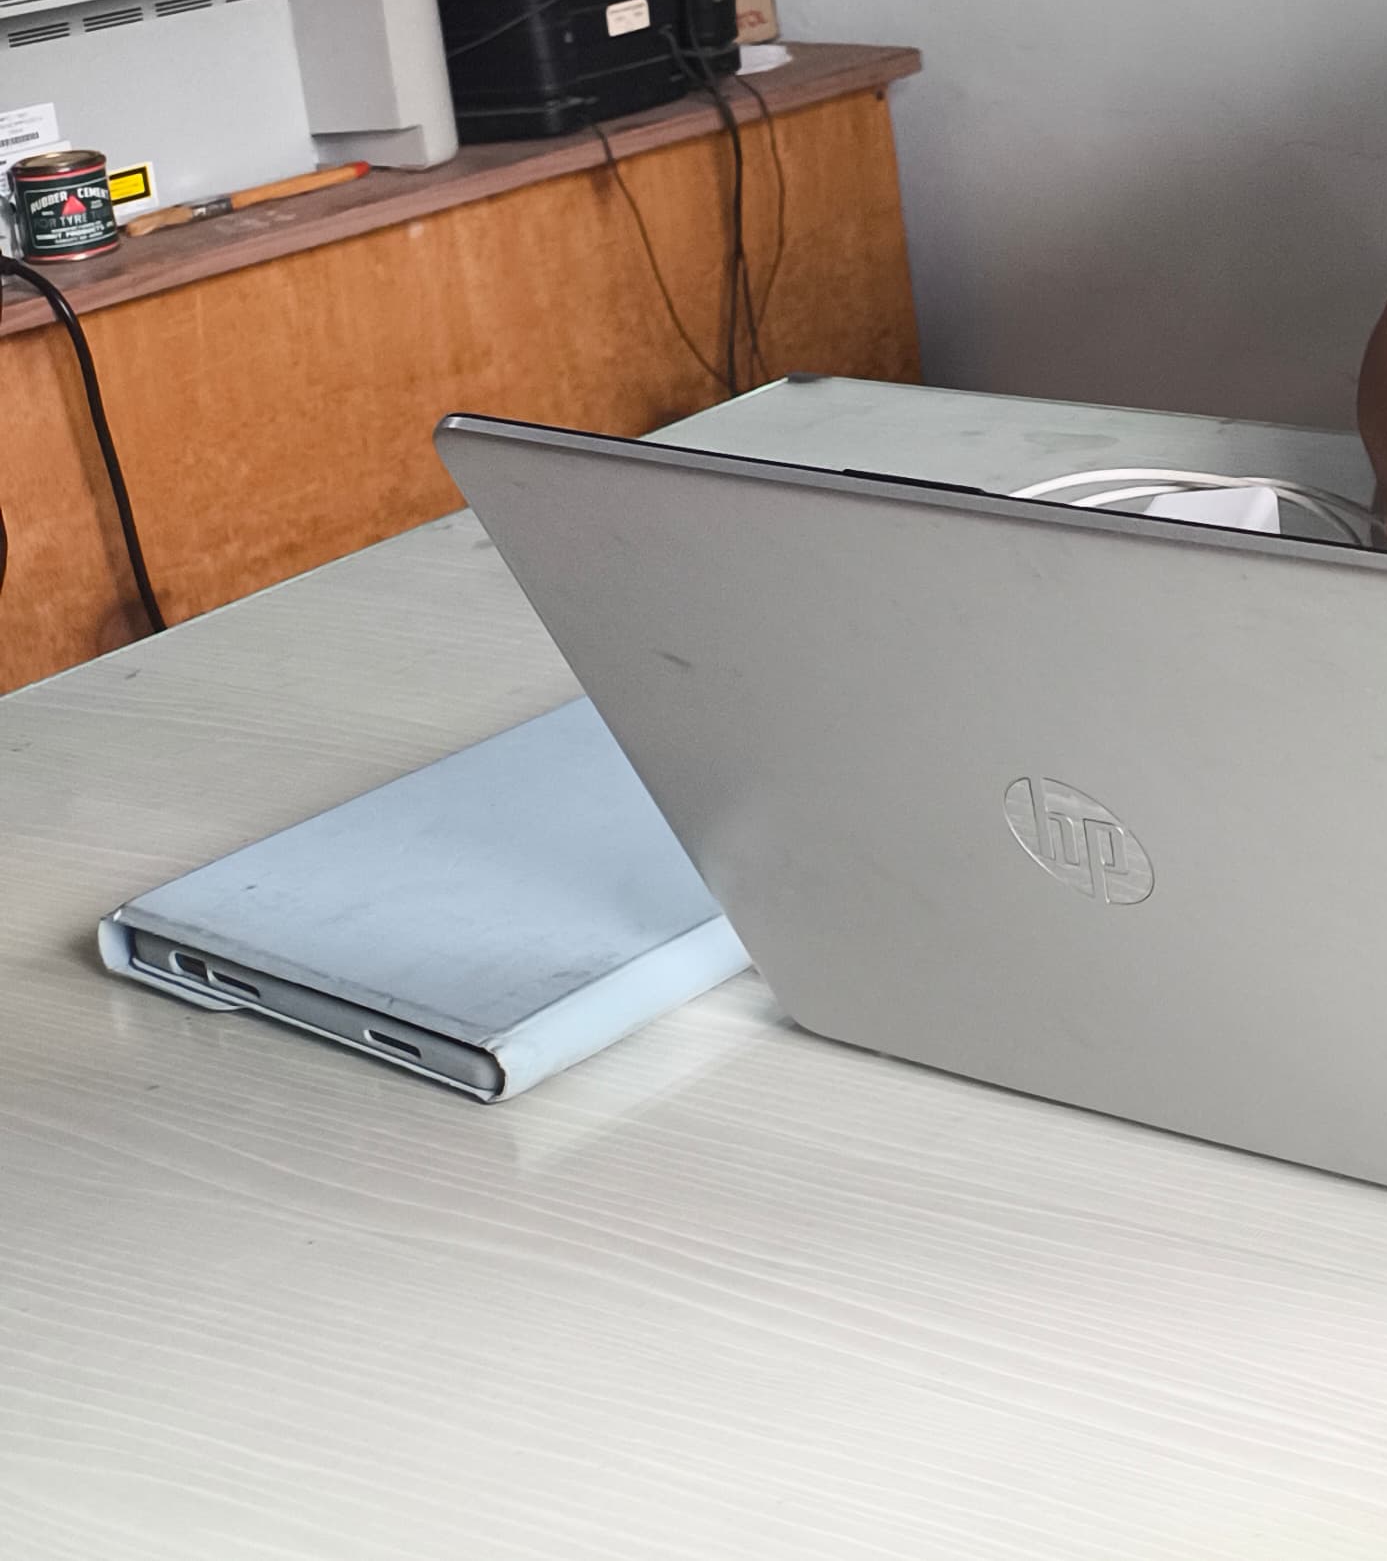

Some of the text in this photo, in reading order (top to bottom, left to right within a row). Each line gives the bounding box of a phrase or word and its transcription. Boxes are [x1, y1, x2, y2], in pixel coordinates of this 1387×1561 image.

[30, 191, 69, 214] RUBBER
[60, 213, 88, 227] TYRE
[1029, 777, 1129, 905] hp
